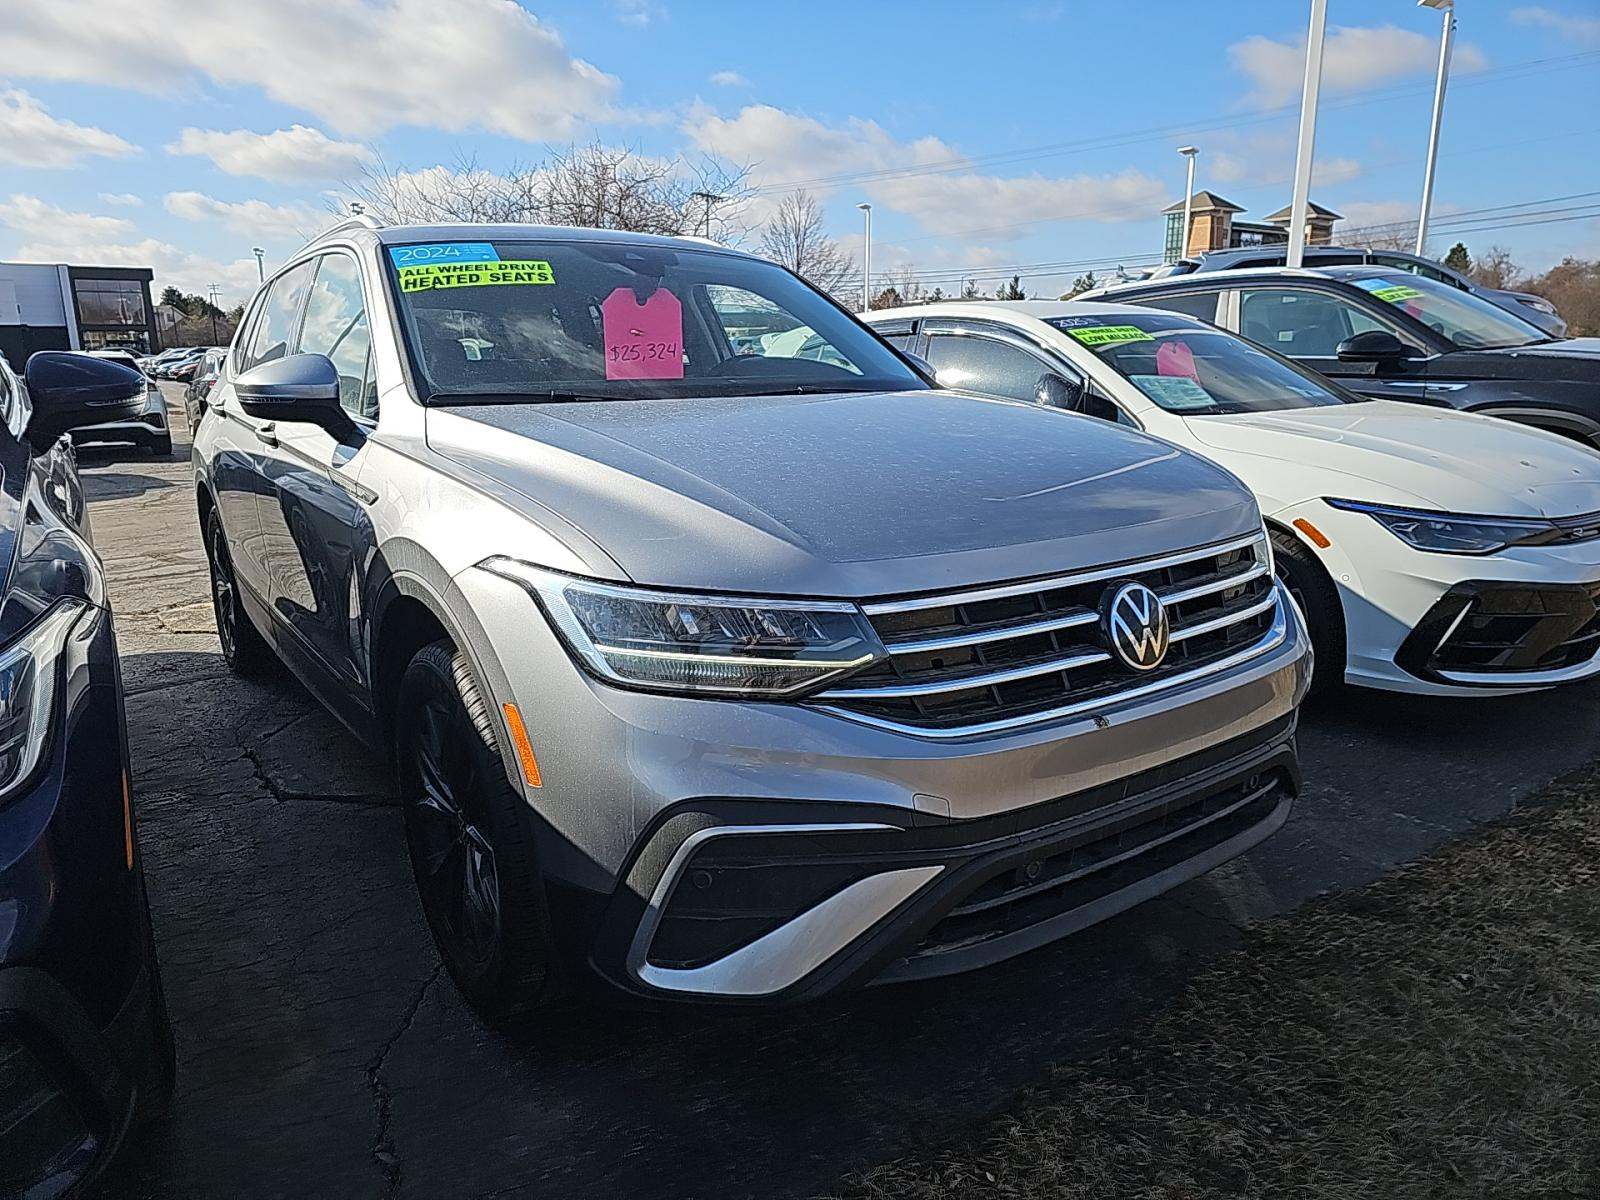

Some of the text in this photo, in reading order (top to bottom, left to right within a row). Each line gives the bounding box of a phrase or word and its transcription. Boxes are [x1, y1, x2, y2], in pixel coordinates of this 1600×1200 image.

[397, 246, 462, 261] 2024
[404, 263, 547, 278] ALL WHEEL DRIVE
[403, 272, 549, 290] HEATED SEATS
[609, 342, 677, 362] $25,324
[1111, 584, 1168, 668] VW
